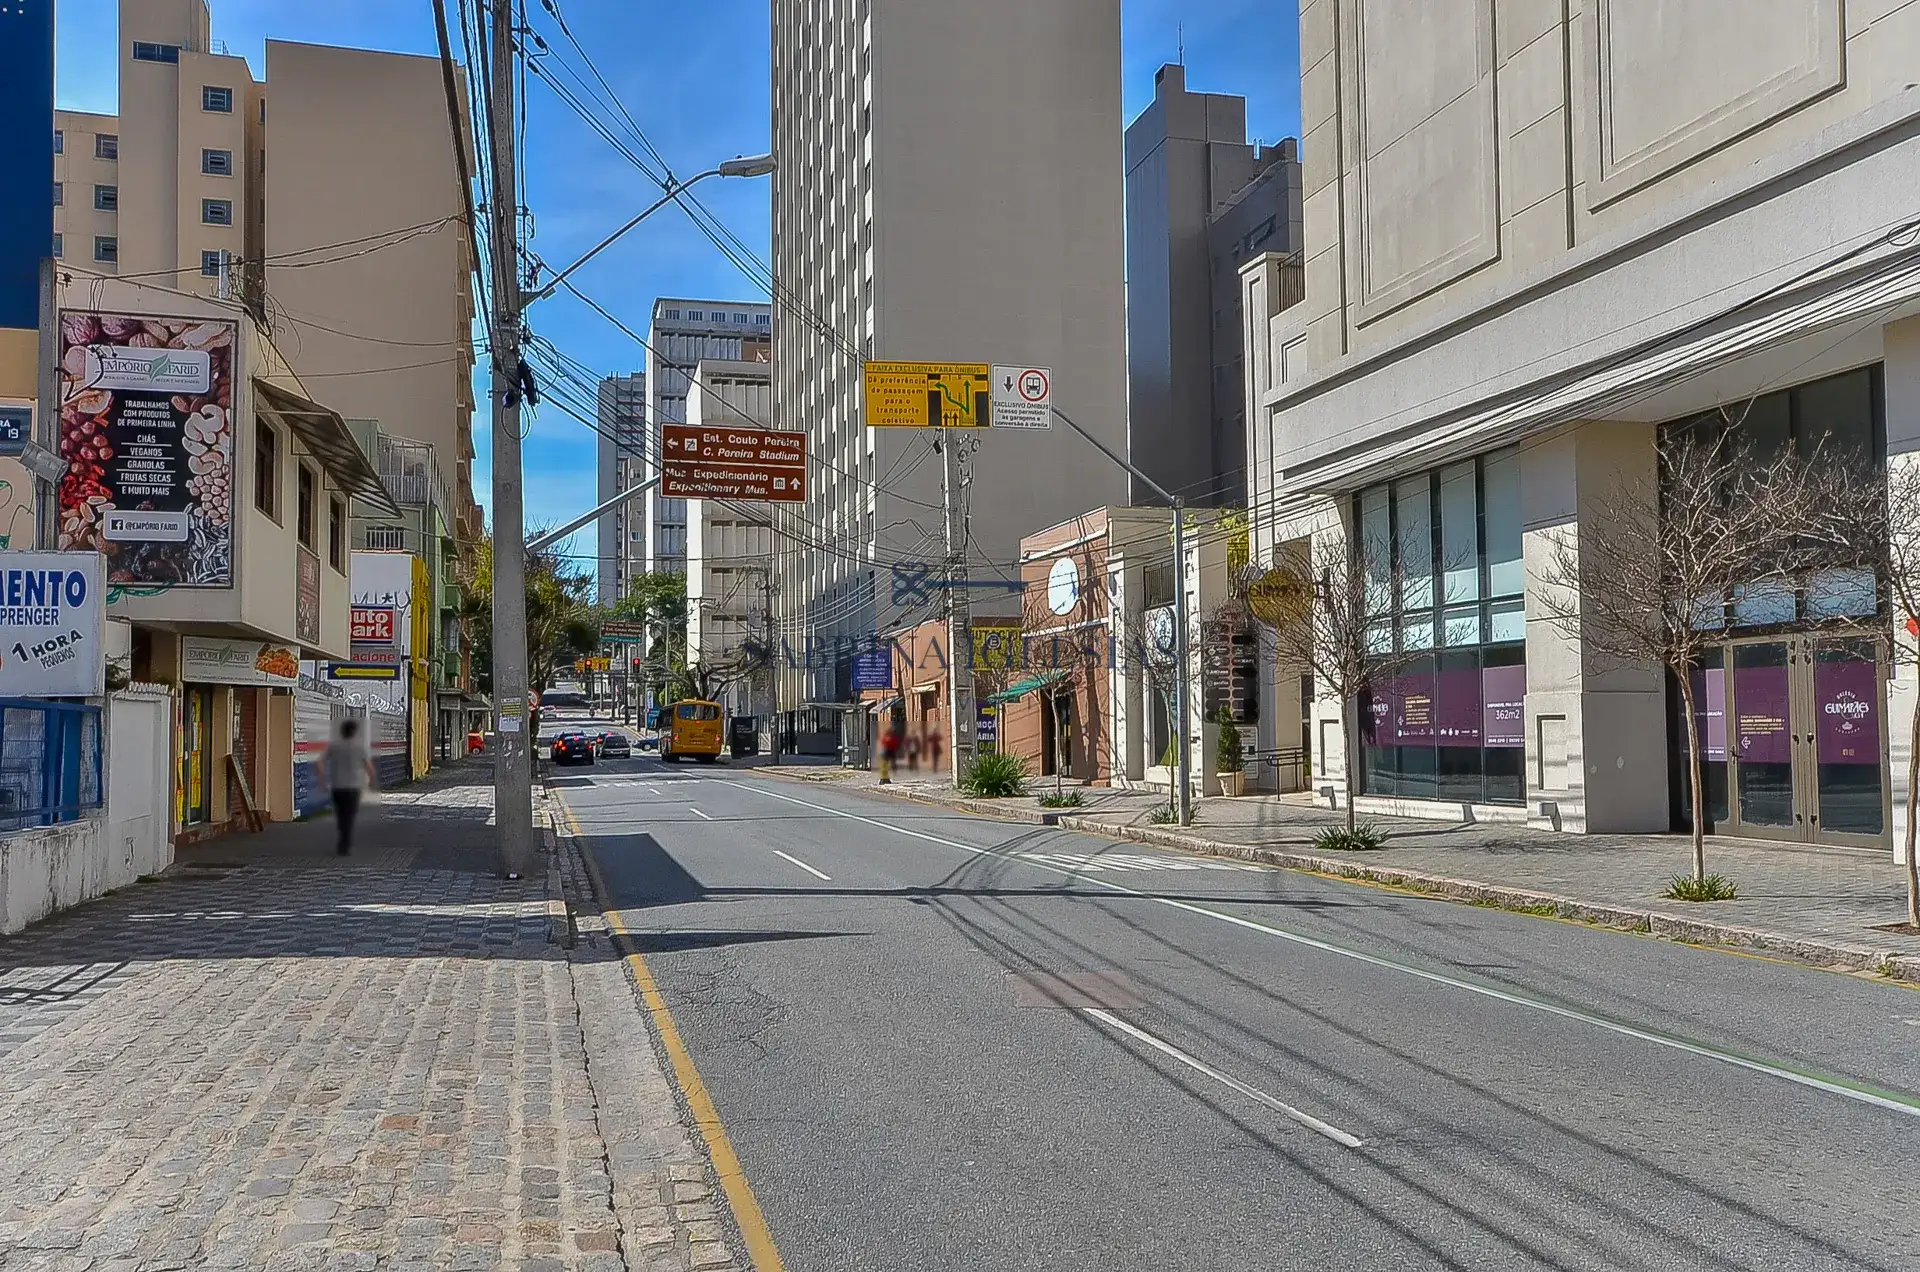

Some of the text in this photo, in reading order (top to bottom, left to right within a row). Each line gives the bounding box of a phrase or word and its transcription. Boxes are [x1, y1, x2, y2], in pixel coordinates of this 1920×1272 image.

[168, 364, 199, 375] FARID
[880, 376, 926, 386] preferência
[125, 400, 170, 410] TRABALHAMOS
[123, 409, 171, 419] COM PRODUTOS
[876, 407, 919, 415] transporte
[117, 418, 126, 427] DE
[127, 419, 157, 428] PRIMEIRA
[882, 416, 915, 424] coletivo
[8, 428, 19, 439] 19
[137, 434, 156, 443] CHÁS
[703, 433, 800, 447] Est. Couto Pereira
[130, 447, 163, 457] VEGANOS
[703, 447, 800, 461] C. Pereira Stadium
[127, 460, 165, 470] GRANOLAS
[121, 473, 171, 483] FRUTAS SECAS
[122, 486, 170, 496] E MUITO MAIS
[745, 484, 769, 495] Mus.
[161, 523, 178, 531] FARID
[353, 609, 388, 624] uto
[352, 623, 389, 637] ark
[12, 629, 84, 663] 1 HORA
[40, 646, 76, 670] PEQUENOS
[1495, 709, 1520, 720] 362m2
